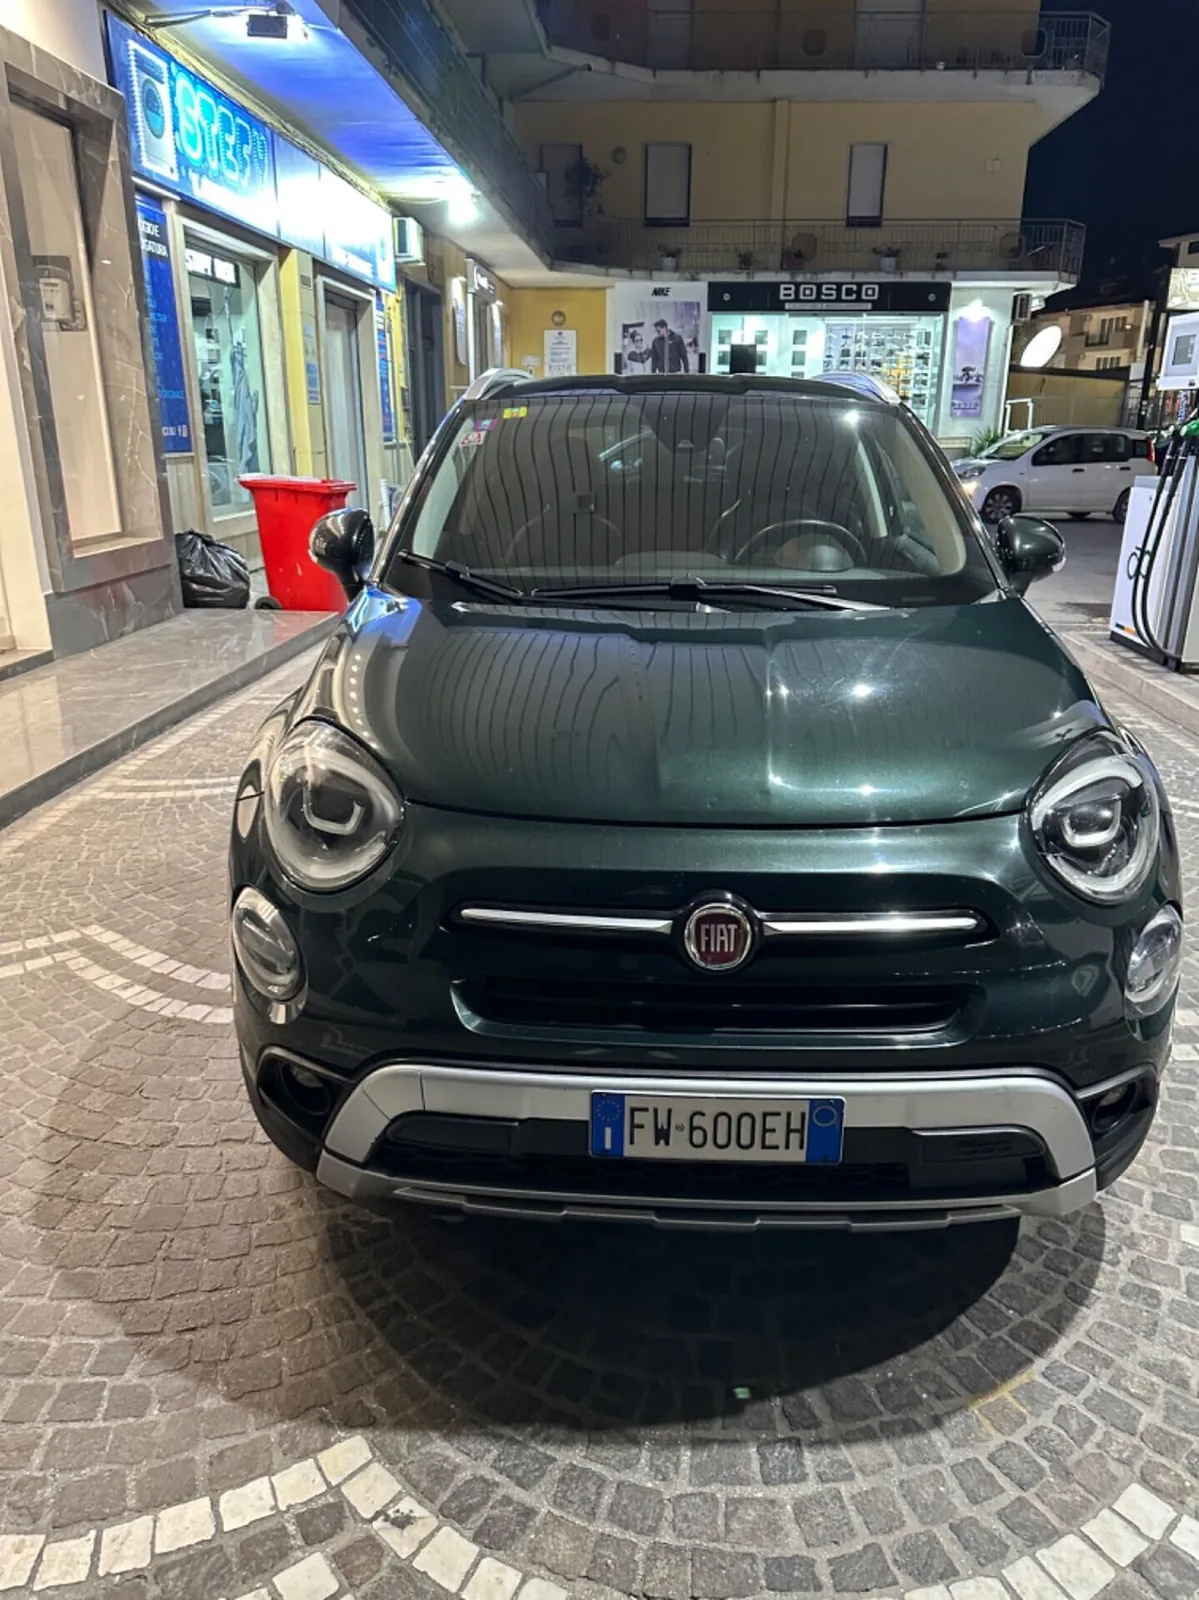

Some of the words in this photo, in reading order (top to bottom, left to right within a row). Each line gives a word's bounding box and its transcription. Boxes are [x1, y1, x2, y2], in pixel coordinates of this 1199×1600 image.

[779, 283, 880, 300] BOSCO
[700, 923, 738, 953] FIAT
[628, 1107, 673, 1146] FW
[688, 1110, 807, 1151] 600EH
